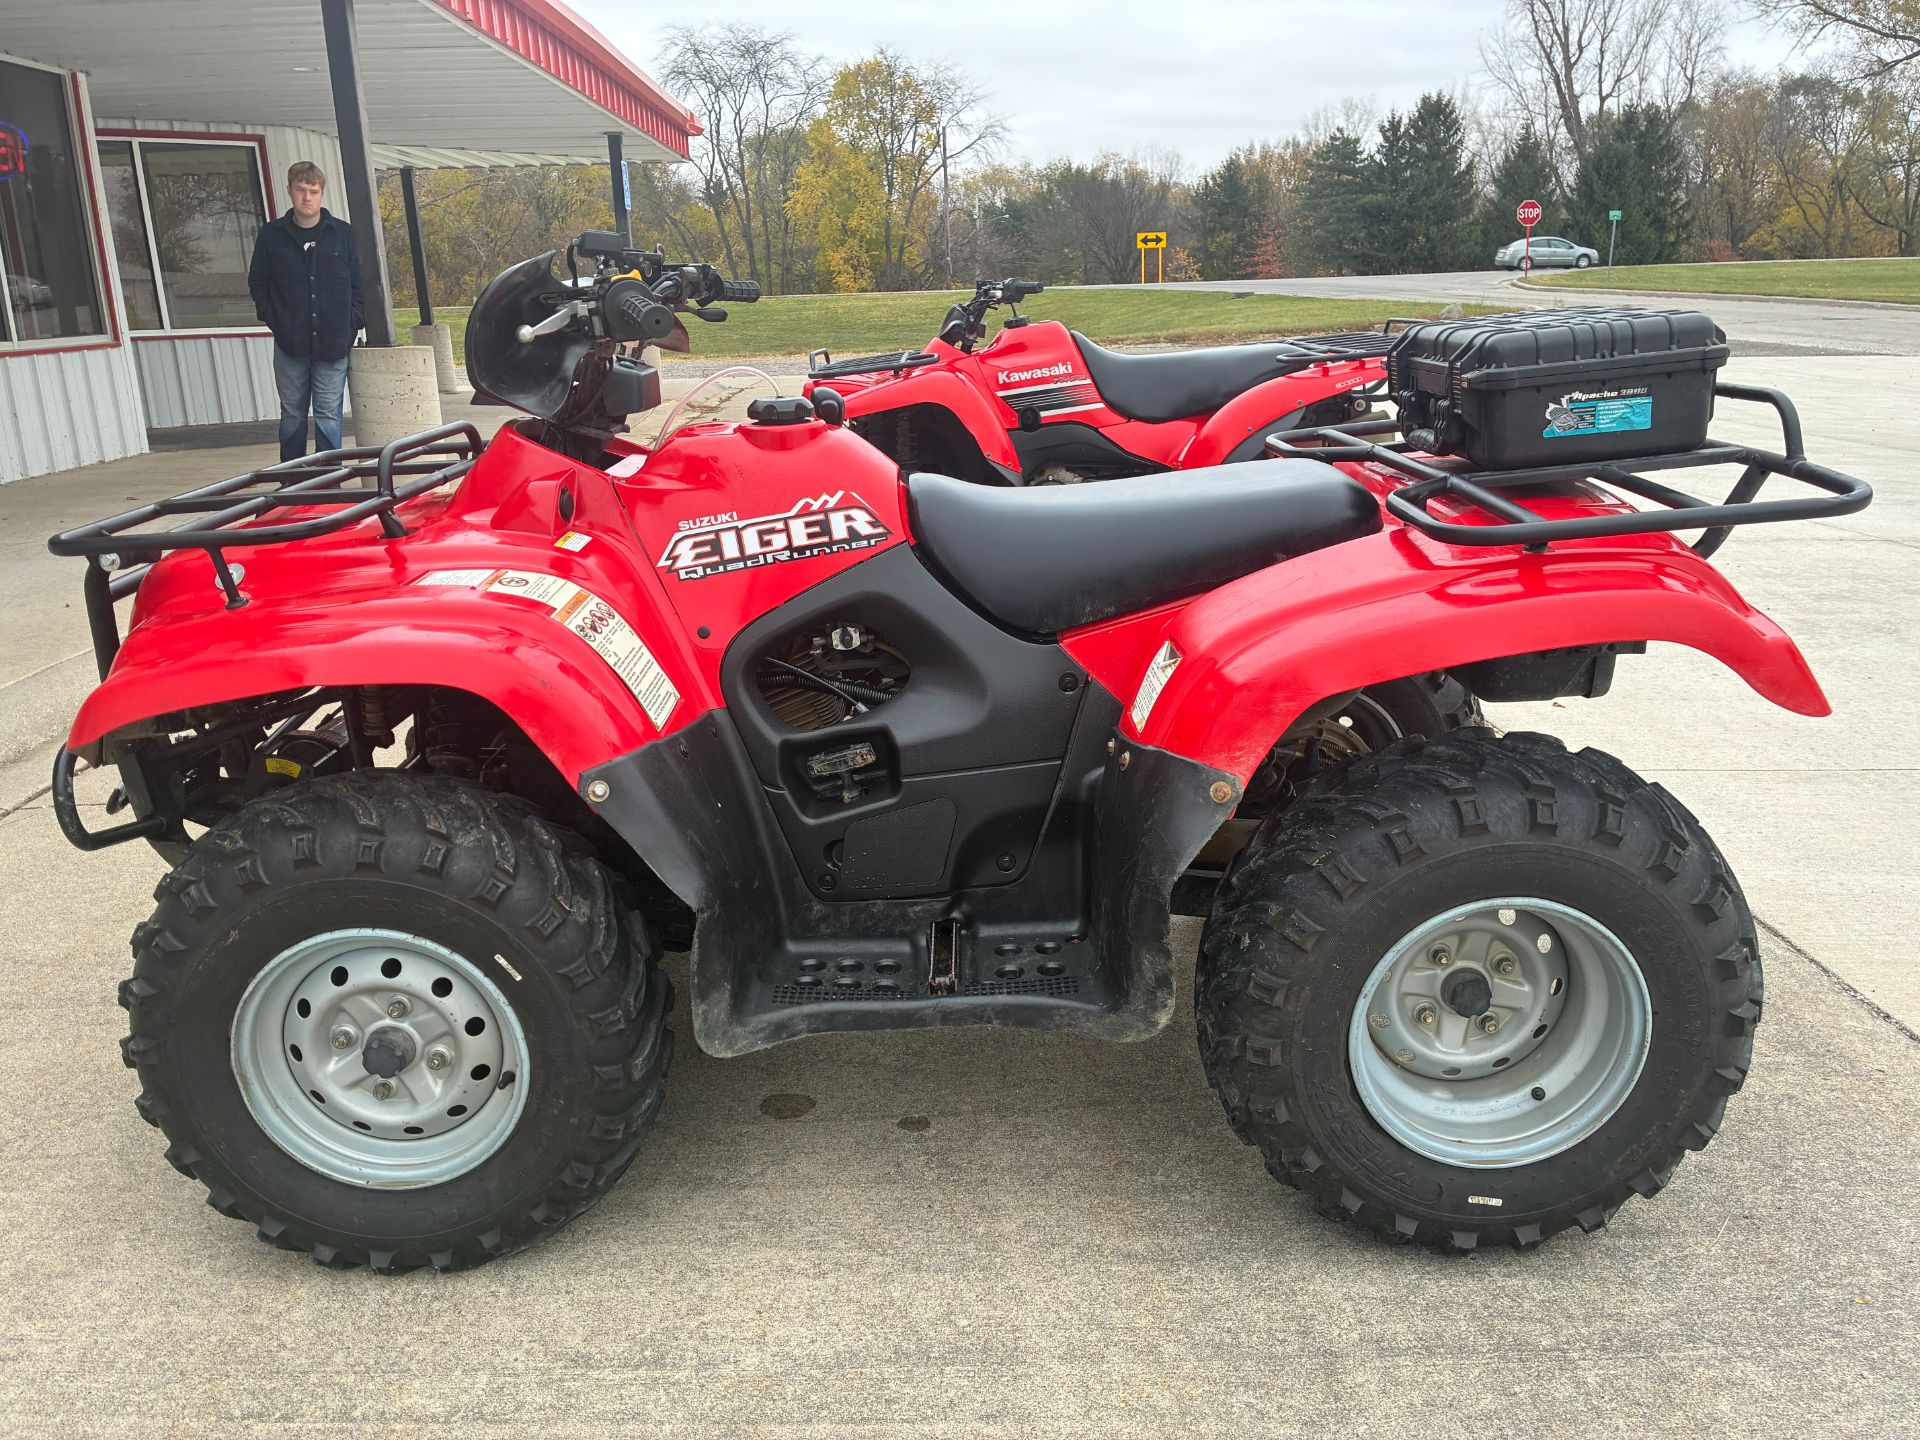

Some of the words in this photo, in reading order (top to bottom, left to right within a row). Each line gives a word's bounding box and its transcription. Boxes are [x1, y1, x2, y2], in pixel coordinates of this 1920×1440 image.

[1519, 208, 1540, 219] STOP
[997, 361, 1073, 385] Kawasaki
[1573, 390, 1618, 401] Apache
[678, 511, 738, 531] SUZUKI
[670, 506, 888, 571] EIGER
[678, 536, 887, 581] QuadRunner
